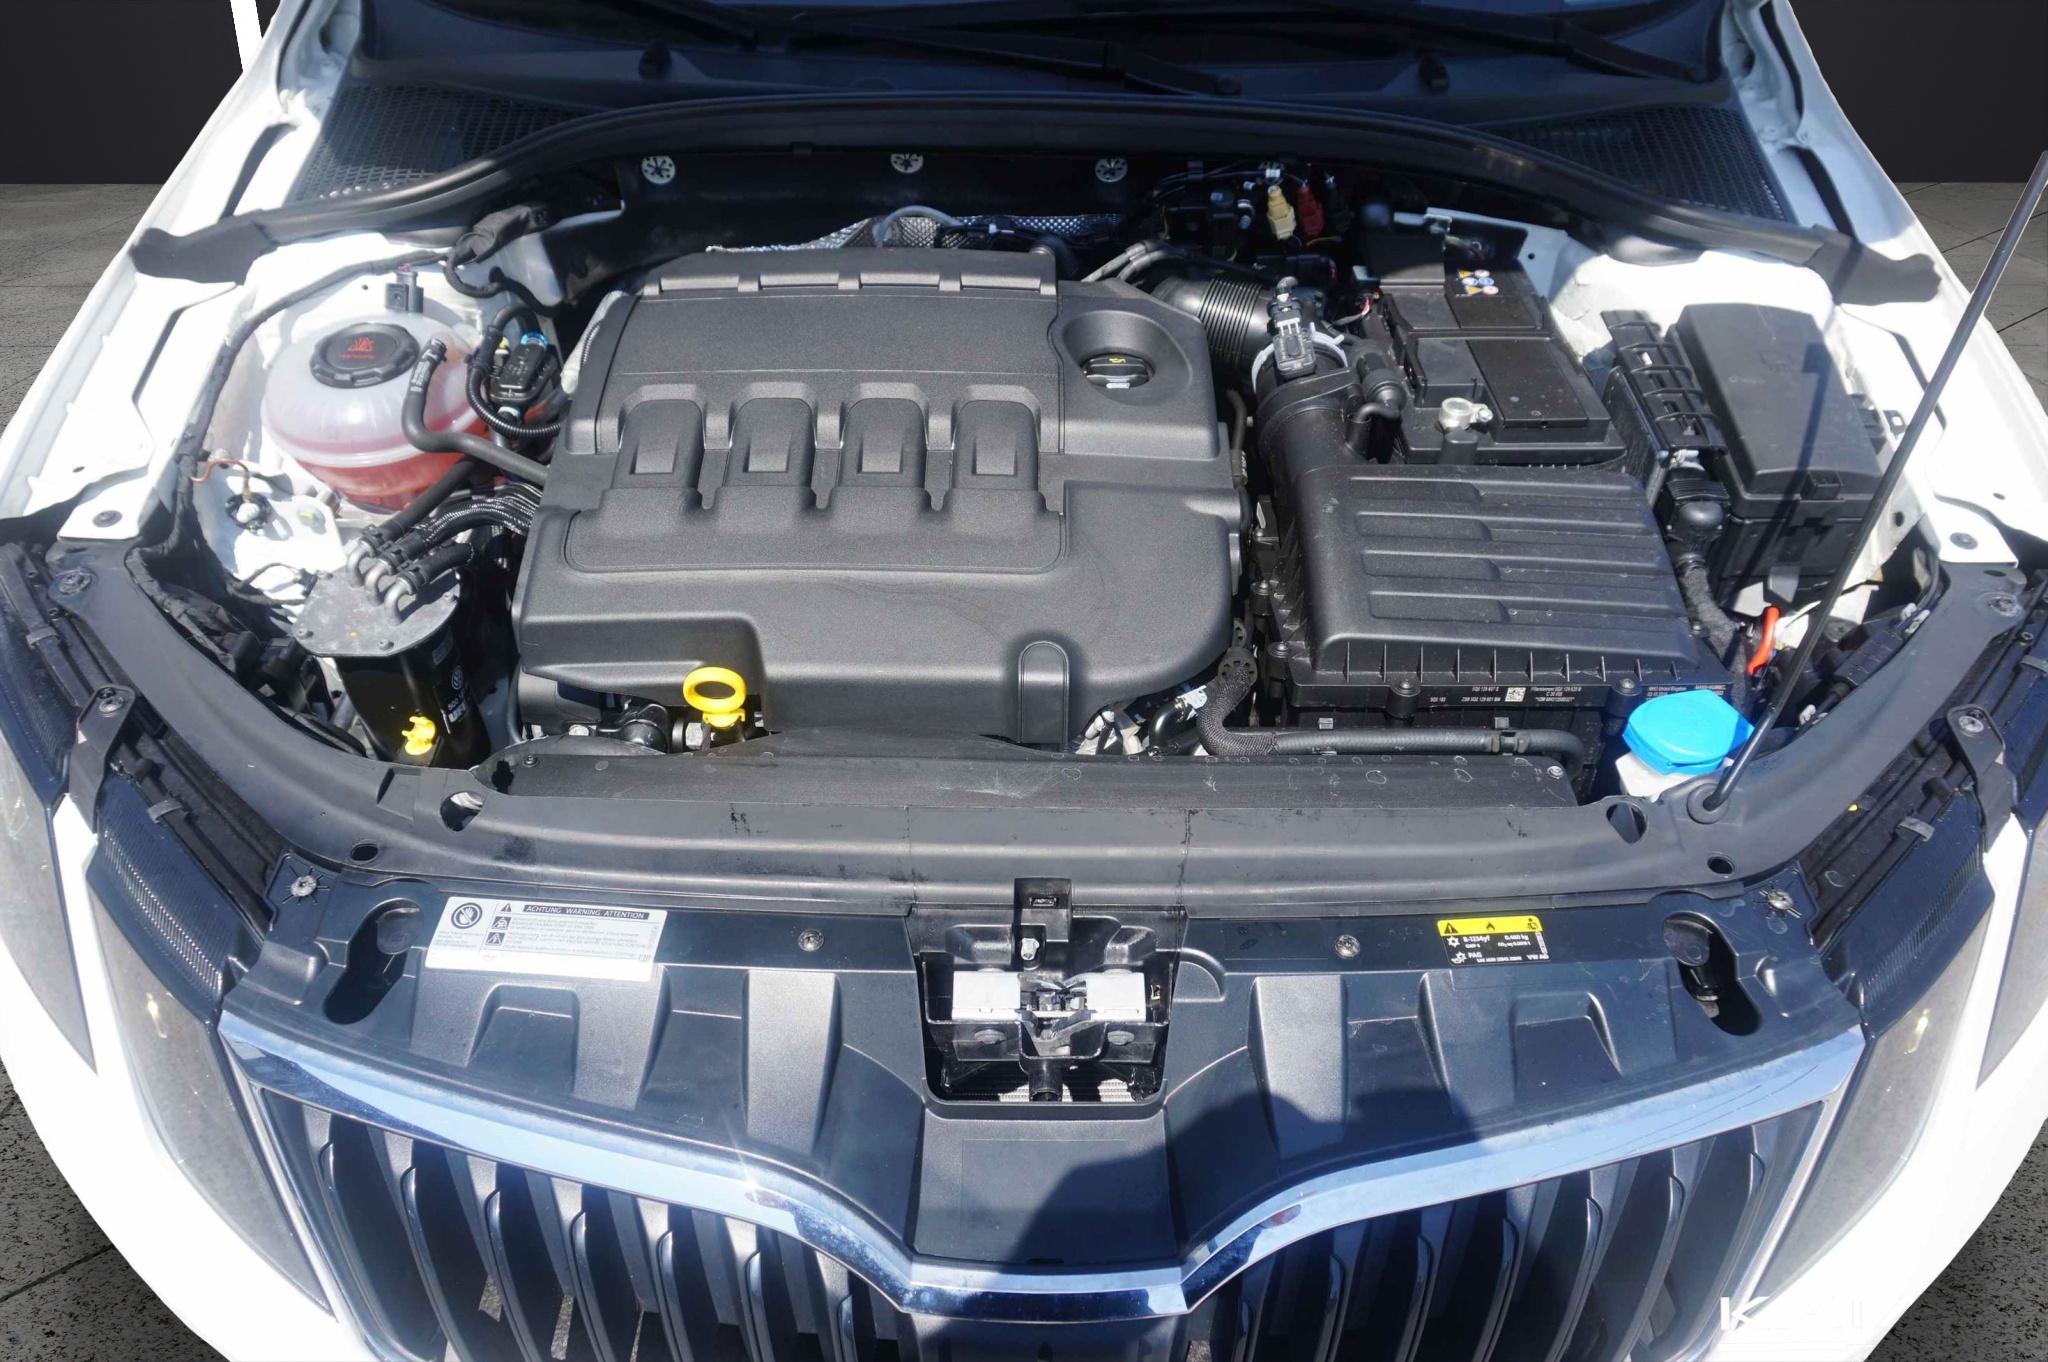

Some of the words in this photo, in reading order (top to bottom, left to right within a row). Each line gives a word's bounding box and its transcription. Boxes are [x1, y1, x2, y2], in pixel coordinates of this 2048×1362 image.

[526, 904, 562, 913] ACHTUNG
[566, 907, 600, 916] WARNING
[604, 910, 645, 919] ATTENTION
